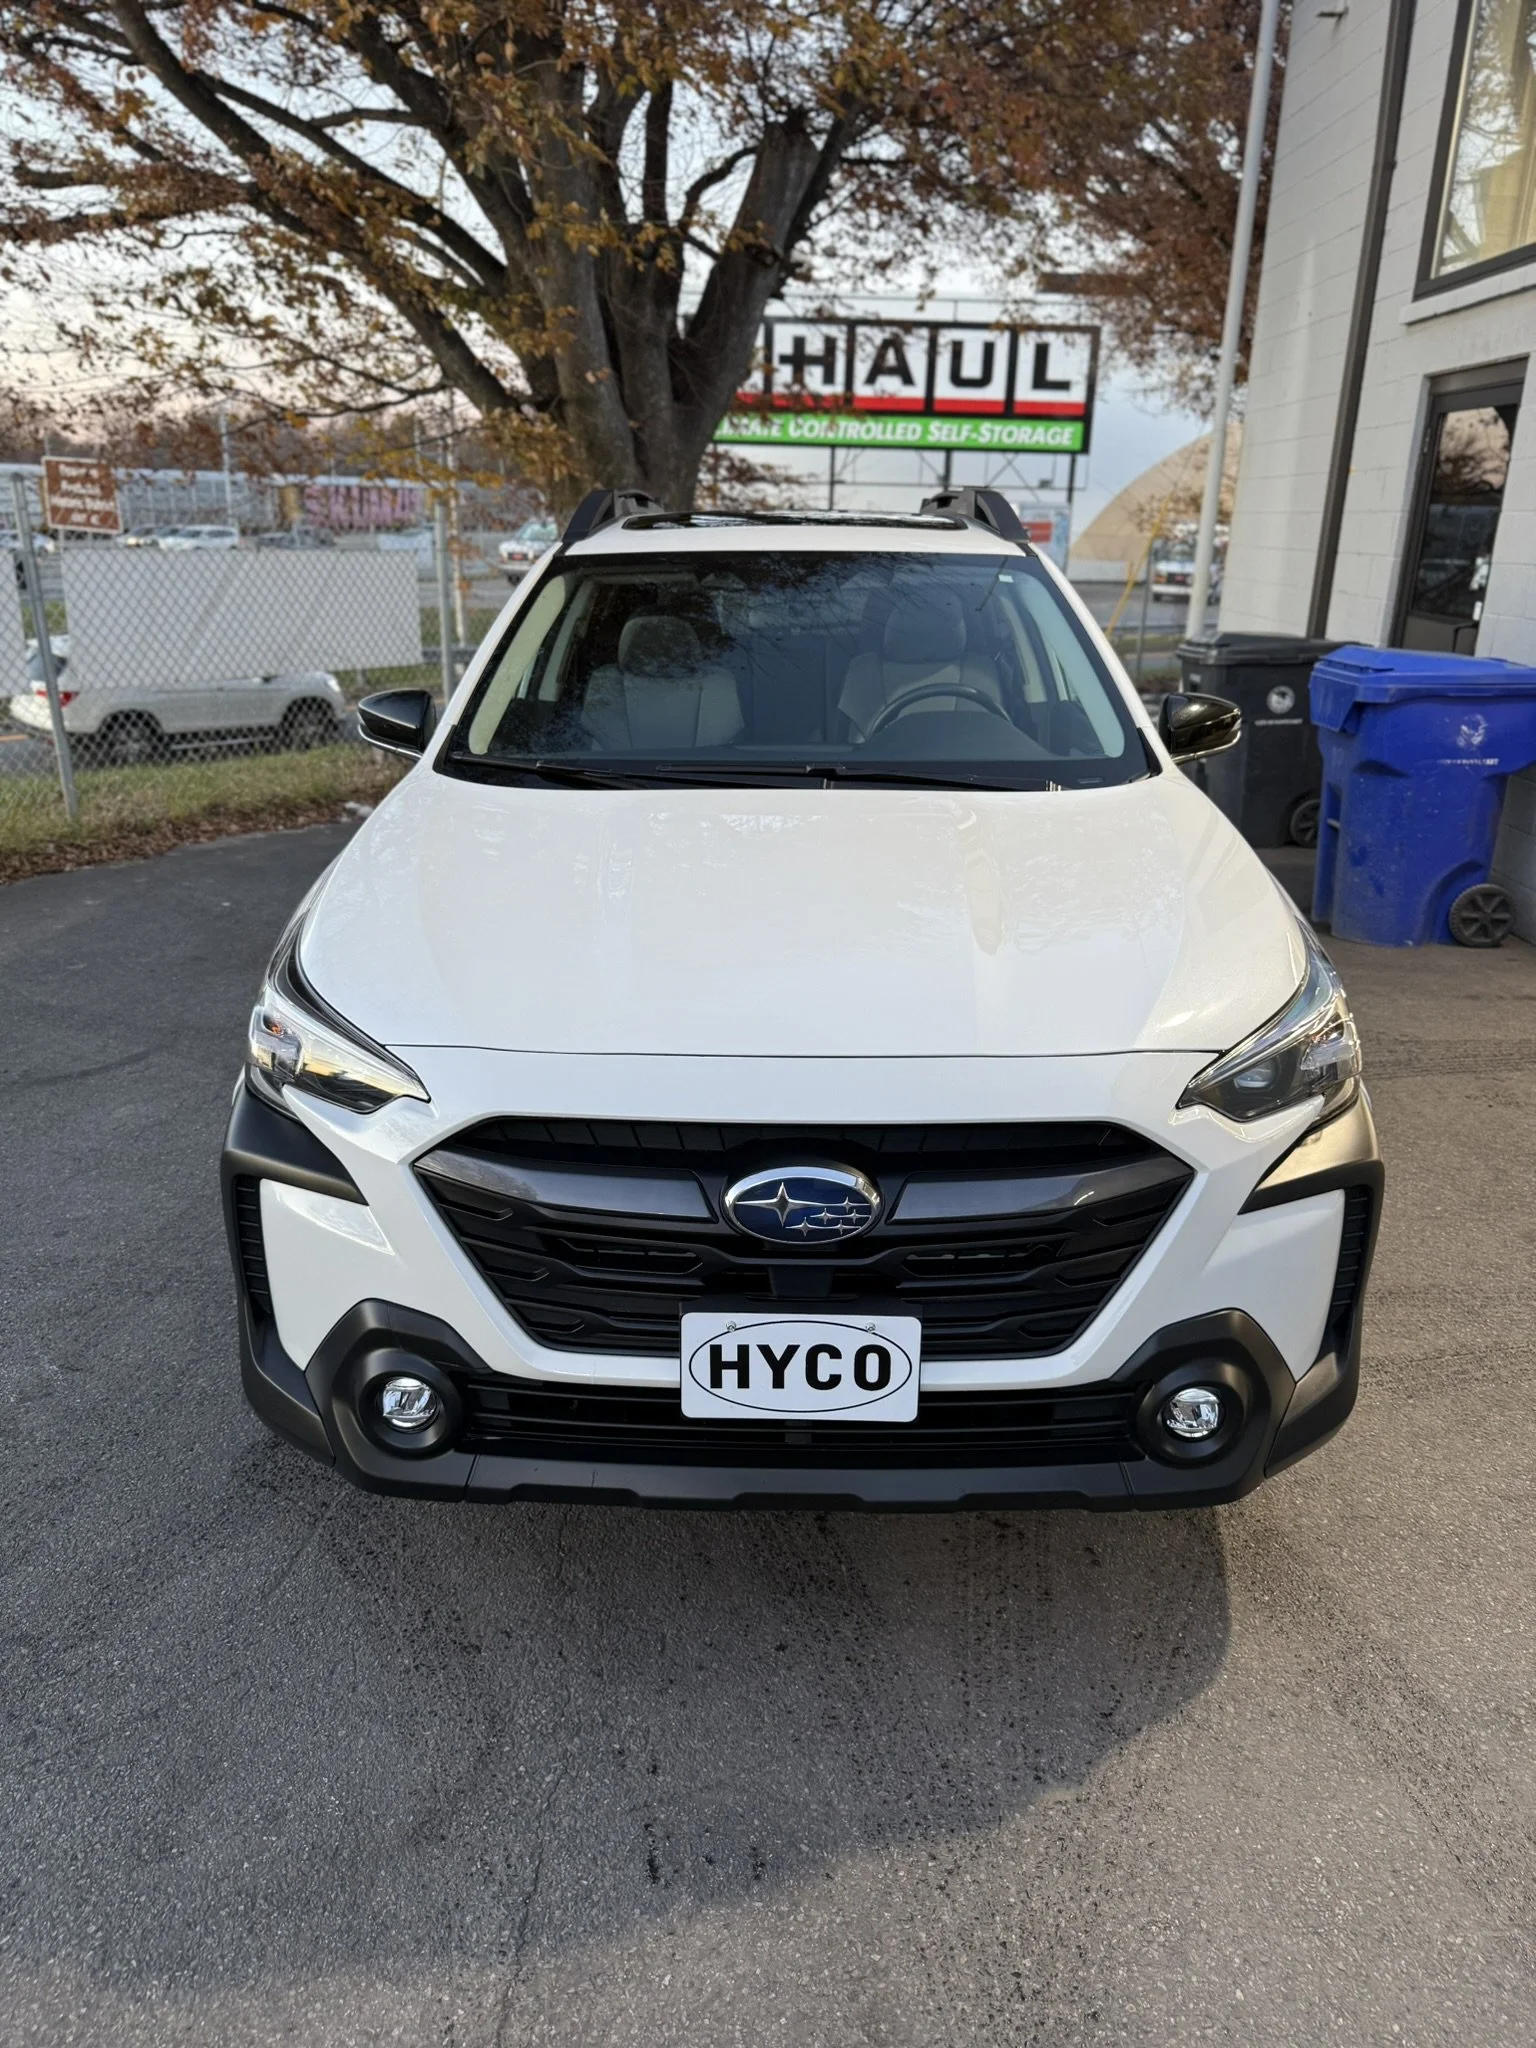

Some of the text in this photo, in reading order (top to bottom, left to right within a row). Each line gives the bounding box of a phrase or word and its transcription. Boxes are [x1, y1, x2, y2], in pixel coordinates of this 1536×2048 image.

[778, 335, 1071, 391] -HAUL
[787, 416, 922, 441] CONTROLLED
[927, 420, 1075, 445] SELF-STORAGE
[708, 1343, 892, 1392] HYCO
